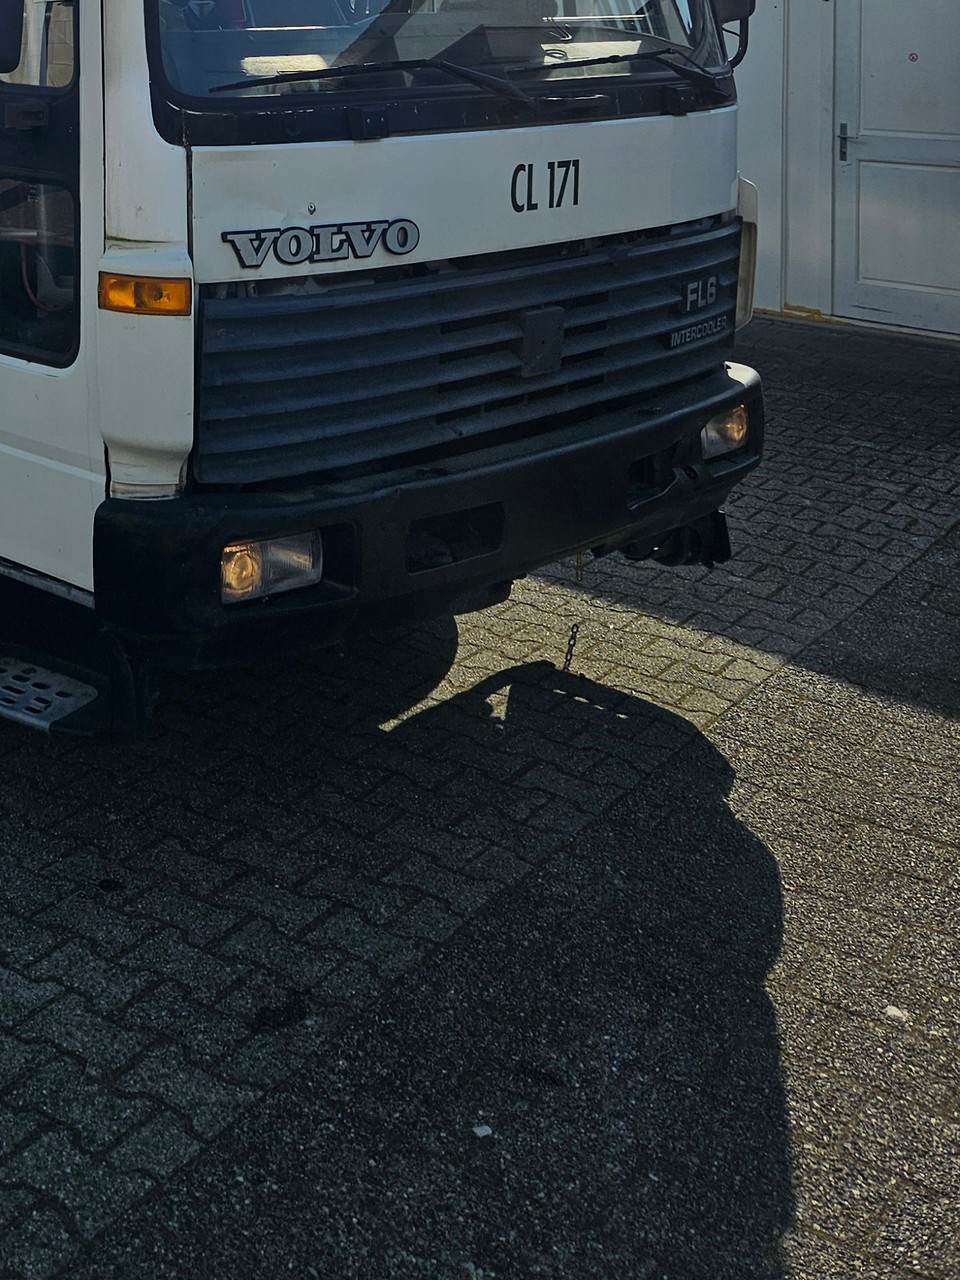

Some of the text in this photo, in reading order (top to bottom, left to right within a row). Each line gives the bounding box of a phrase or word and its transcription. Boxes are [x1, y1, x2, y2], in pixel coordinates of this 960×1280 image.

[511, 159, 579, 213] CL 171
[221, 219, 420, 268] VOLVO
[686, 276, 717, 311] FL6
[671, 316, 727, 347] INTERCOOLER
